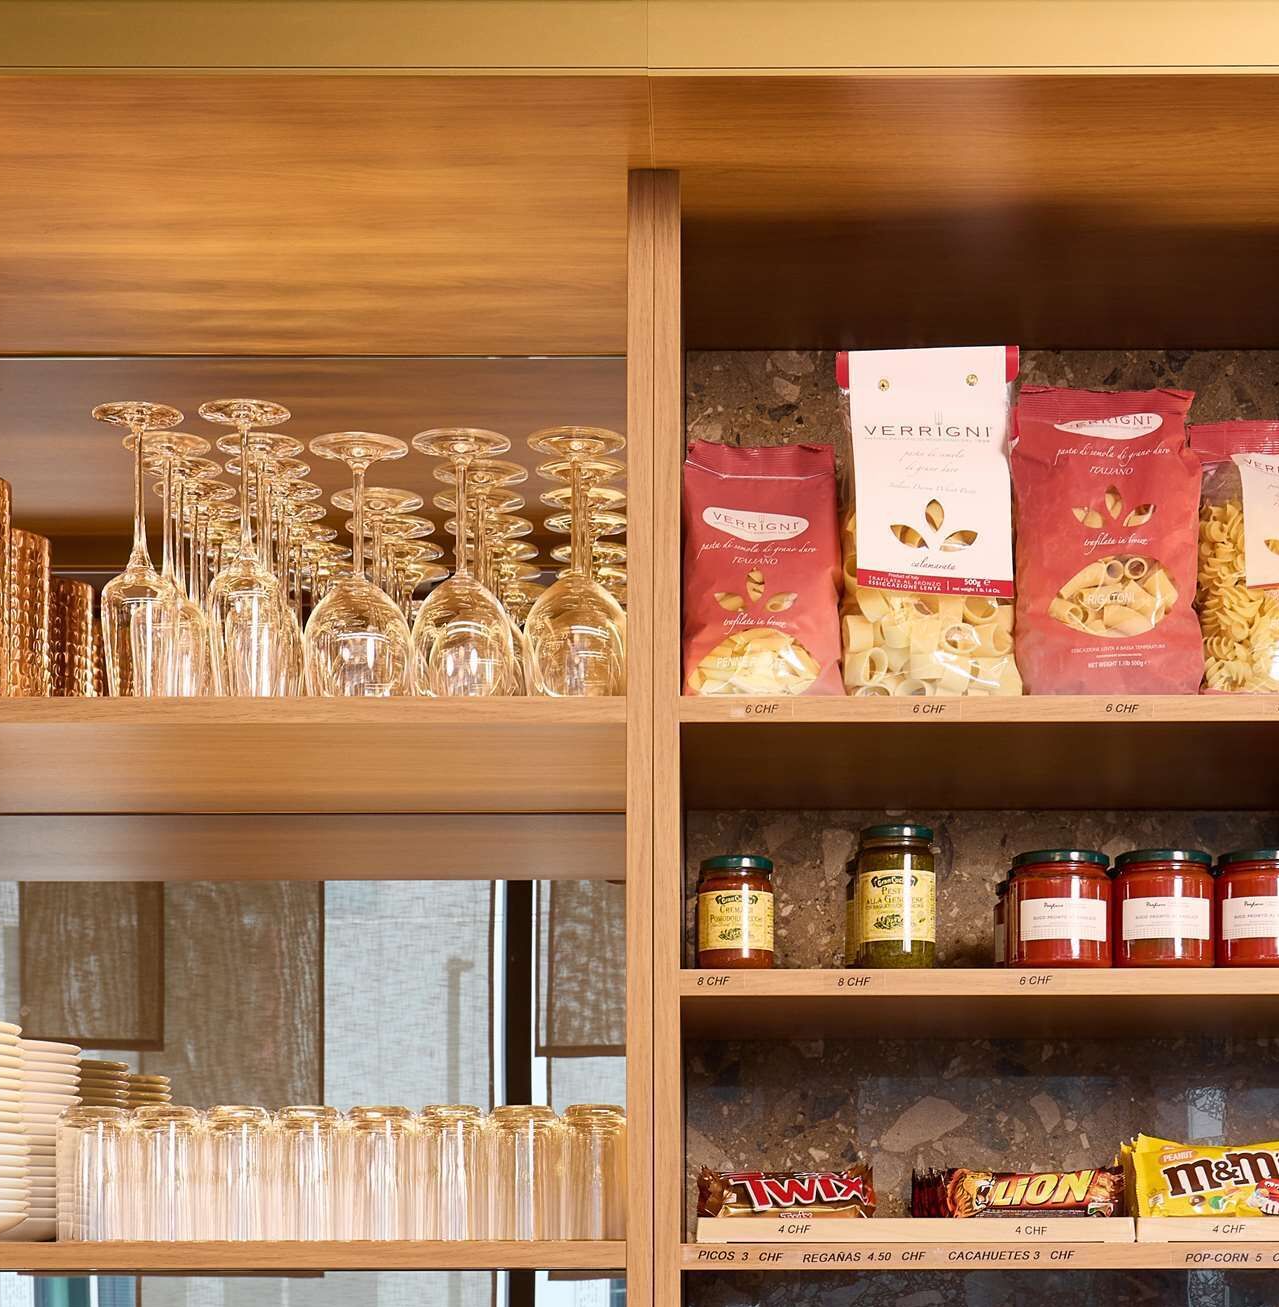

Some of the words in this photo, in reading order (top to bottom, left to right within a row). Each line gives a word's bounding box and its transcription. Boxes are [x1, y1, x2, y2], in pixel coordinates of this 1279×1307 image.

[864, 425, 990, 438] VERRIGNI
[1090, 466, 1134, 476] ITALIANO
[713, 511, 799, 531] VERRIGNI
[920, 584, 942, 592] LENTA
[964, 578, 981, 588] 500g
[1087, 591, 1136, 604] RIGATONI
[745, 704, 752, 714] 6
[755, 704, 779, 714] CHF
[913, 704, 919, 714] 6
[922, 704, 946, 714] CHF
[1105, 704, 1112, 713] 6
[1115, 703, 1139, 713] CHF
[697, 977, 704, 986] 8
[706, 976, 730, 986] CHF
[837, 977, 845, 987] 8
[847, 976, 871, 987] CHF
[1019, 976, 1026, 986] 6
[1029, 975, 1053, 985] CHF
[1162, 1150, 1194, 1163] PEANUT
[778, 1225, 785, 1233] 4
[787, 1225, 811, 1234] CHF
[1015, 1226, 1021, 1235] 4
[1025, 1226, 1048, 1235] CHF
[1212, 1225, 1219, 1233] 4
[1222, 1224, 1246, 1234] CHF
[698, 1250, 735, 1260] PICOS
[742, 1252, 749, 1261] 3
[759, 1252, 784, 1262] CHF
[803, 1251, 861, 1263] REGAÑAS
[868, 1252, 892, 1261] 4.50
[901, 1251, 926, 1261] CHF
[948, 1250, 1030, 1261] CACAHUETES
[1033, 1251, 1040, 1260] 3
[1050, 1250, 1075, 1260] CHF
[1185, 1253, 1249, 1263] POP-CORN
[1255, 1253, 1262, 1262] 5
